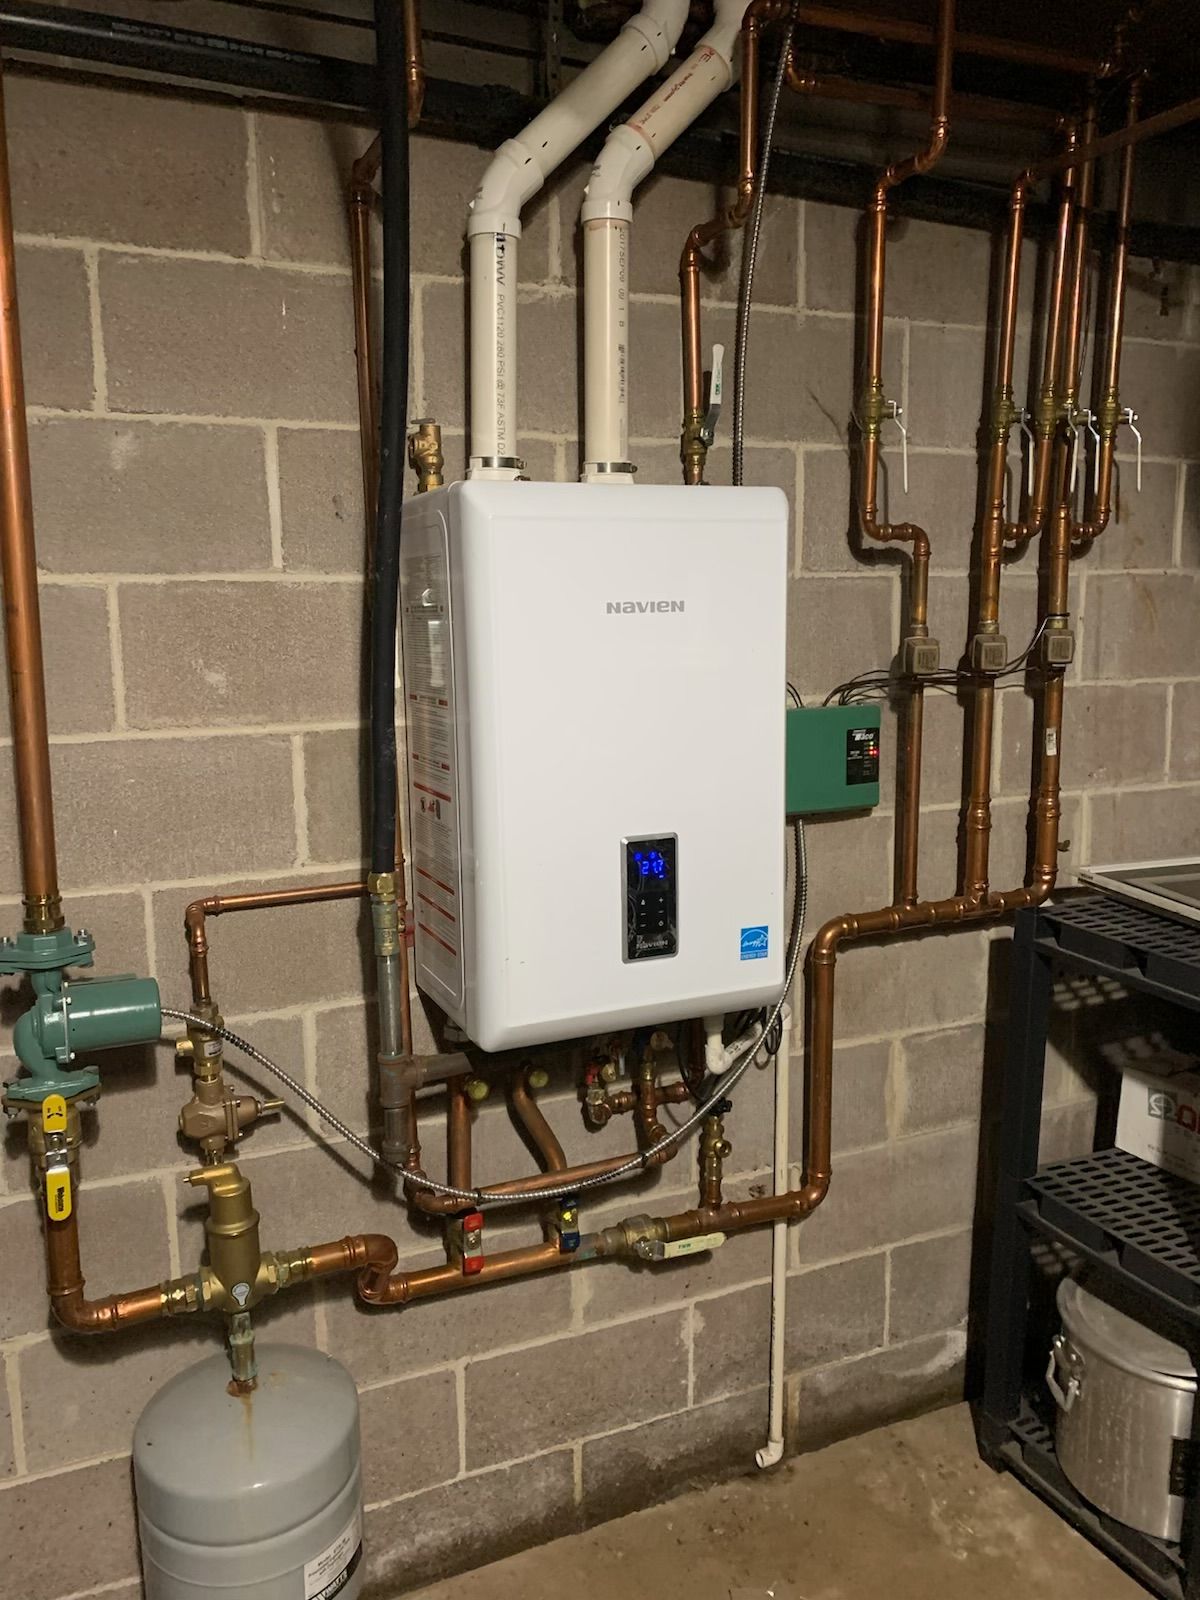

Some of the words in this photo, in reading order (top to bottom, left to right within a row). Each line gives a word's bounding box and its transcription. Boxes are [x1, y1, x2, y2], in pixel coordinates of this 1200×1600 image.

[496, 293, 505, 339] PVC1120
[496, 360, 505, 378] PSI
[496, 411, 506, 441] ASTM
